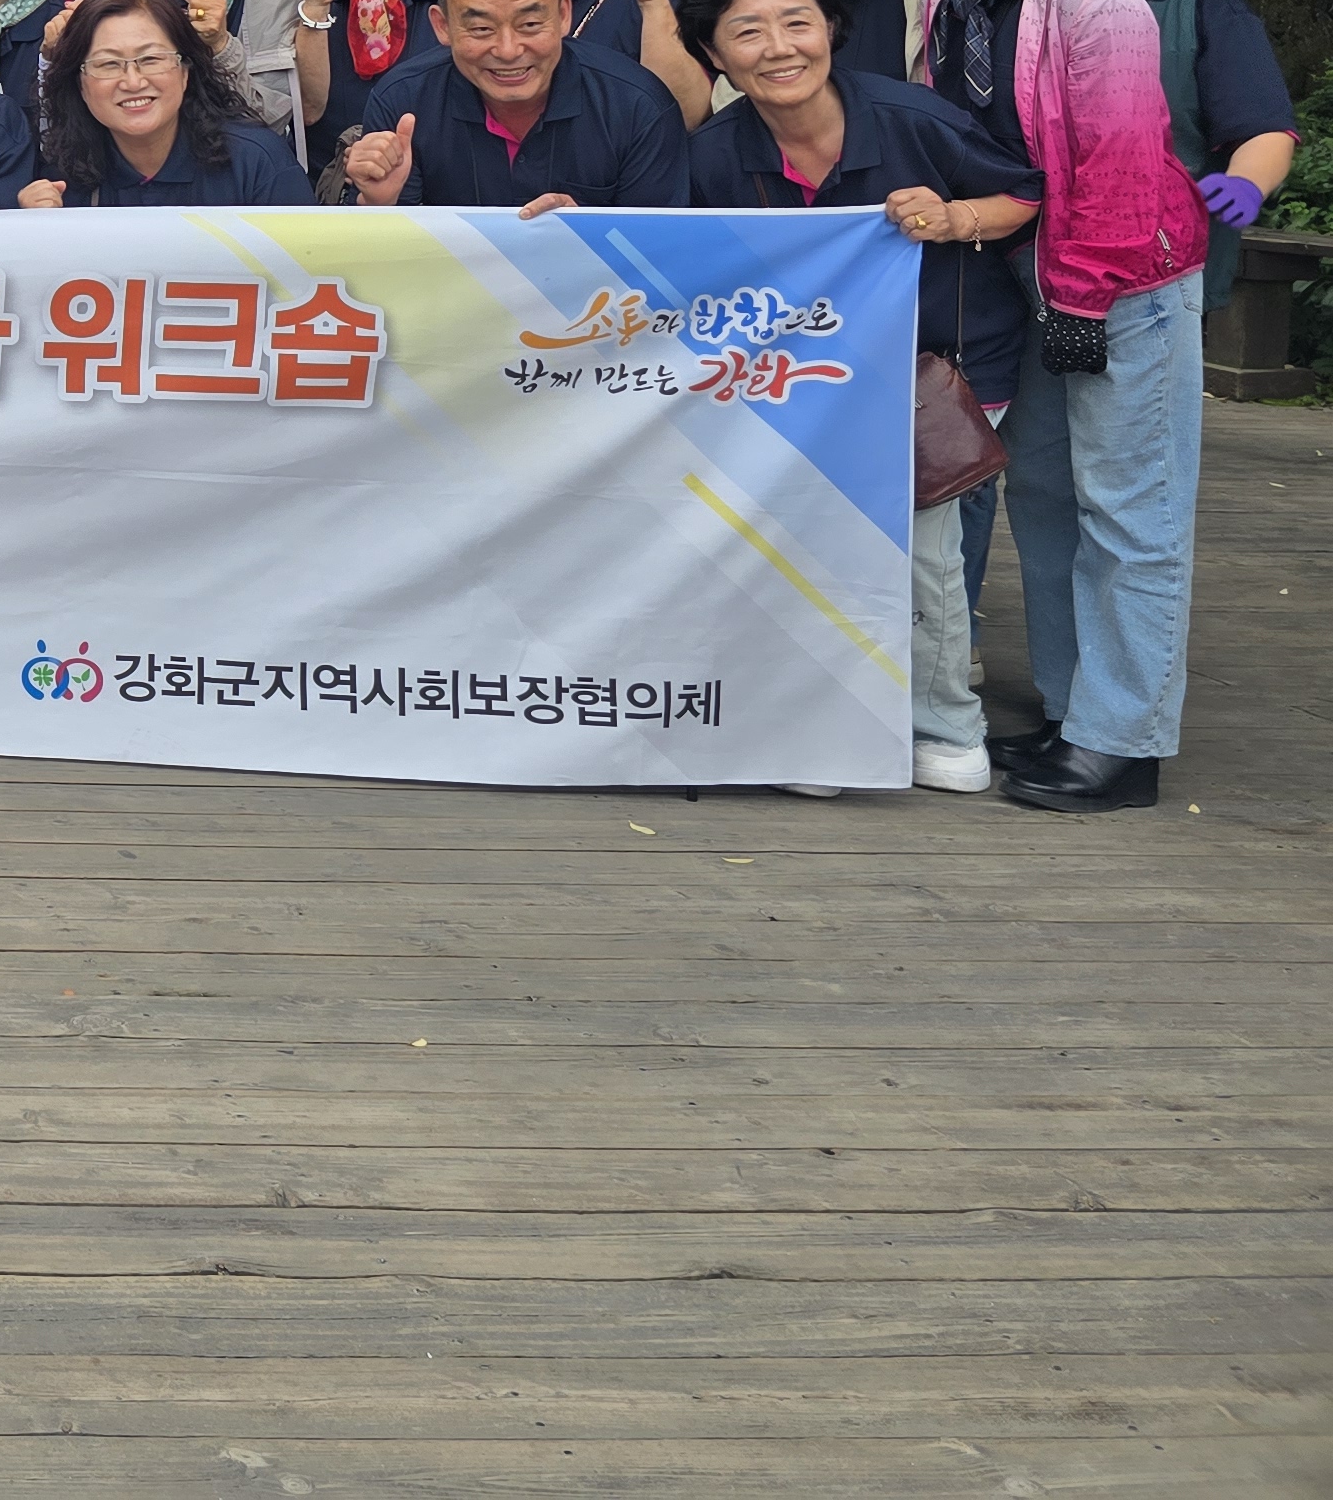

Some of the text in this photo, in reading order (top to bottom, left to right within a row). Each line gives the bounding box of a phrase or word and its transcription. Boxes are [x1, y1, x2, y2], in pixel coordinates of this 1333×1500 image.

[43, 278, 381, 403] 워크숍
[519, 291, 838, 349] 소통과 화합으로
[504, 350, 848, 402] 함께 만드는 강화
[113, 652, 723, 728] 강화군지역사회보장협의체
